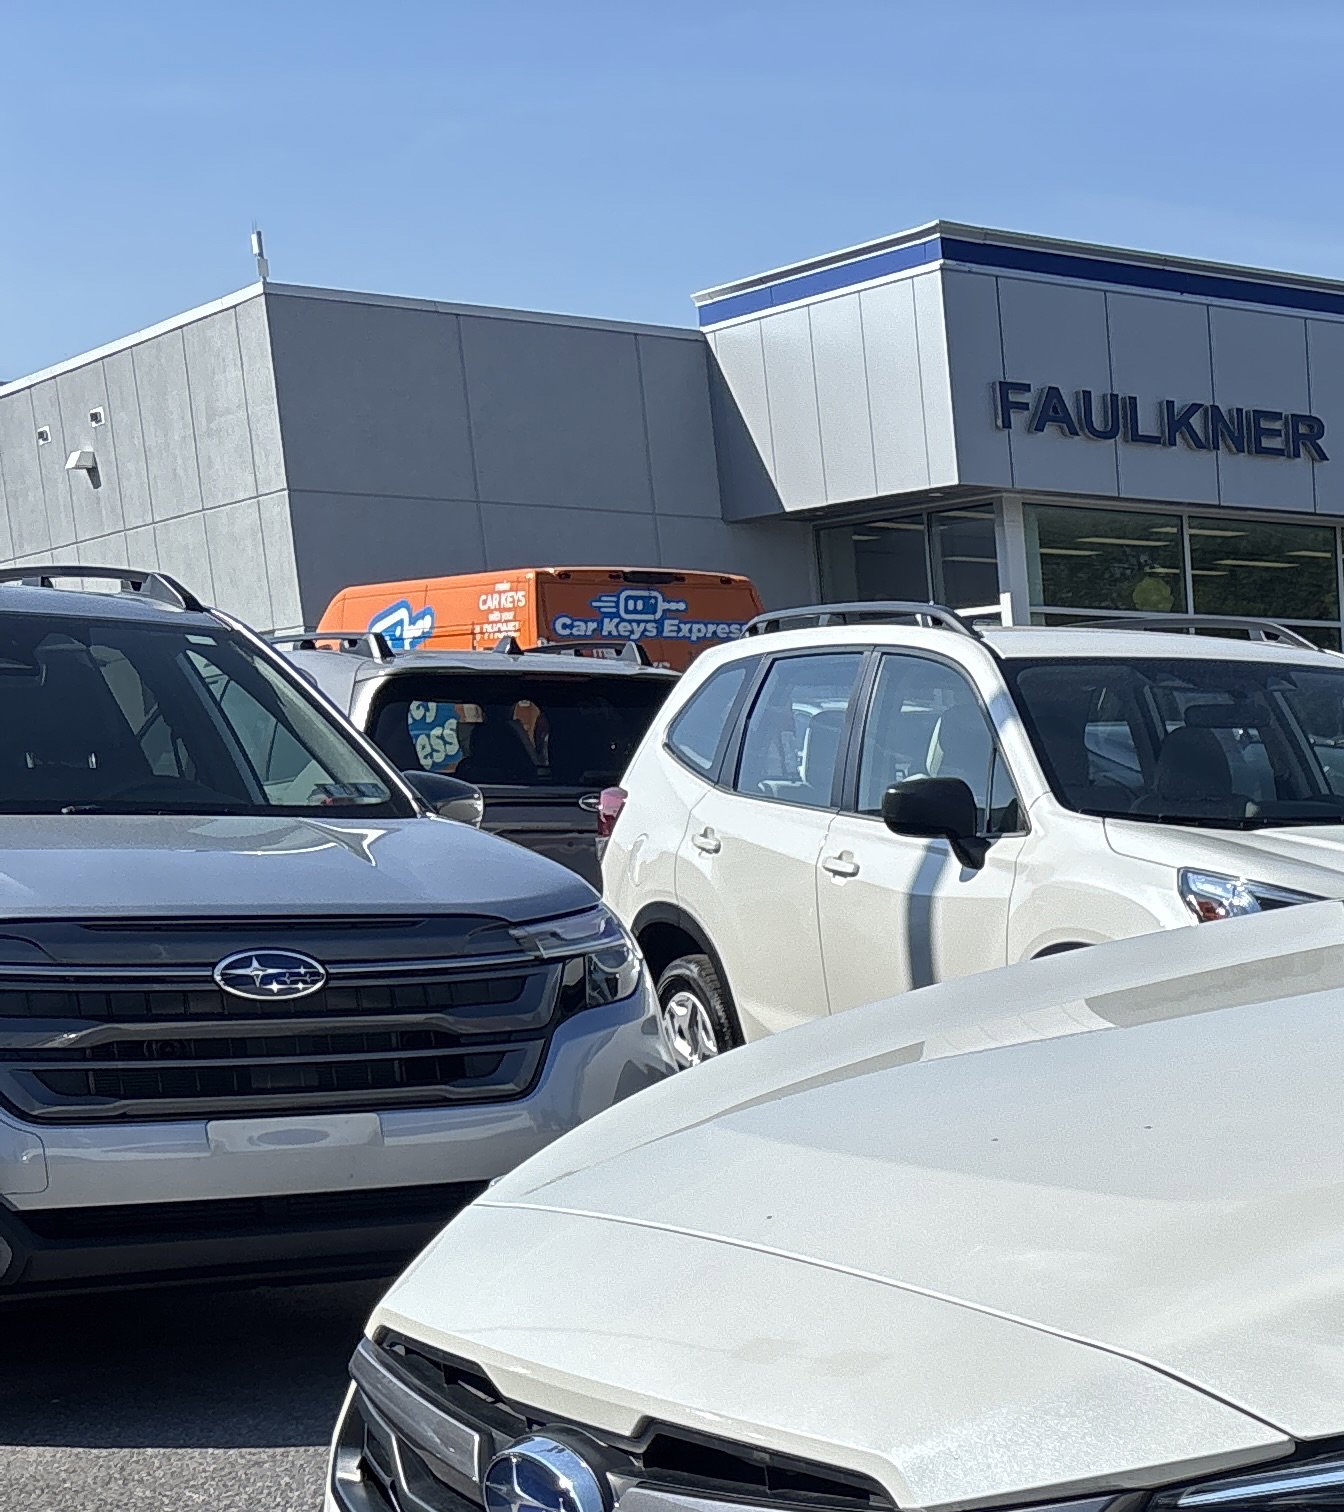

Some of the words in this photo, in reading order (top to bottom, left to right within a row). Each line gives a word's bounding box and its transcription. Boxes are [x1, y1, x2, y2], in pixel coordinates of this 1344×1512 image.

[995, 380, 1330, 462] FAULKNER
[479, 593, 500, 611] CAR
[501, 590, 526, 609] KEYS
[554, 616, 598, 636] Car
[602, 617, 657, 640] Keys
[662, 619, 745, 641] Expres
